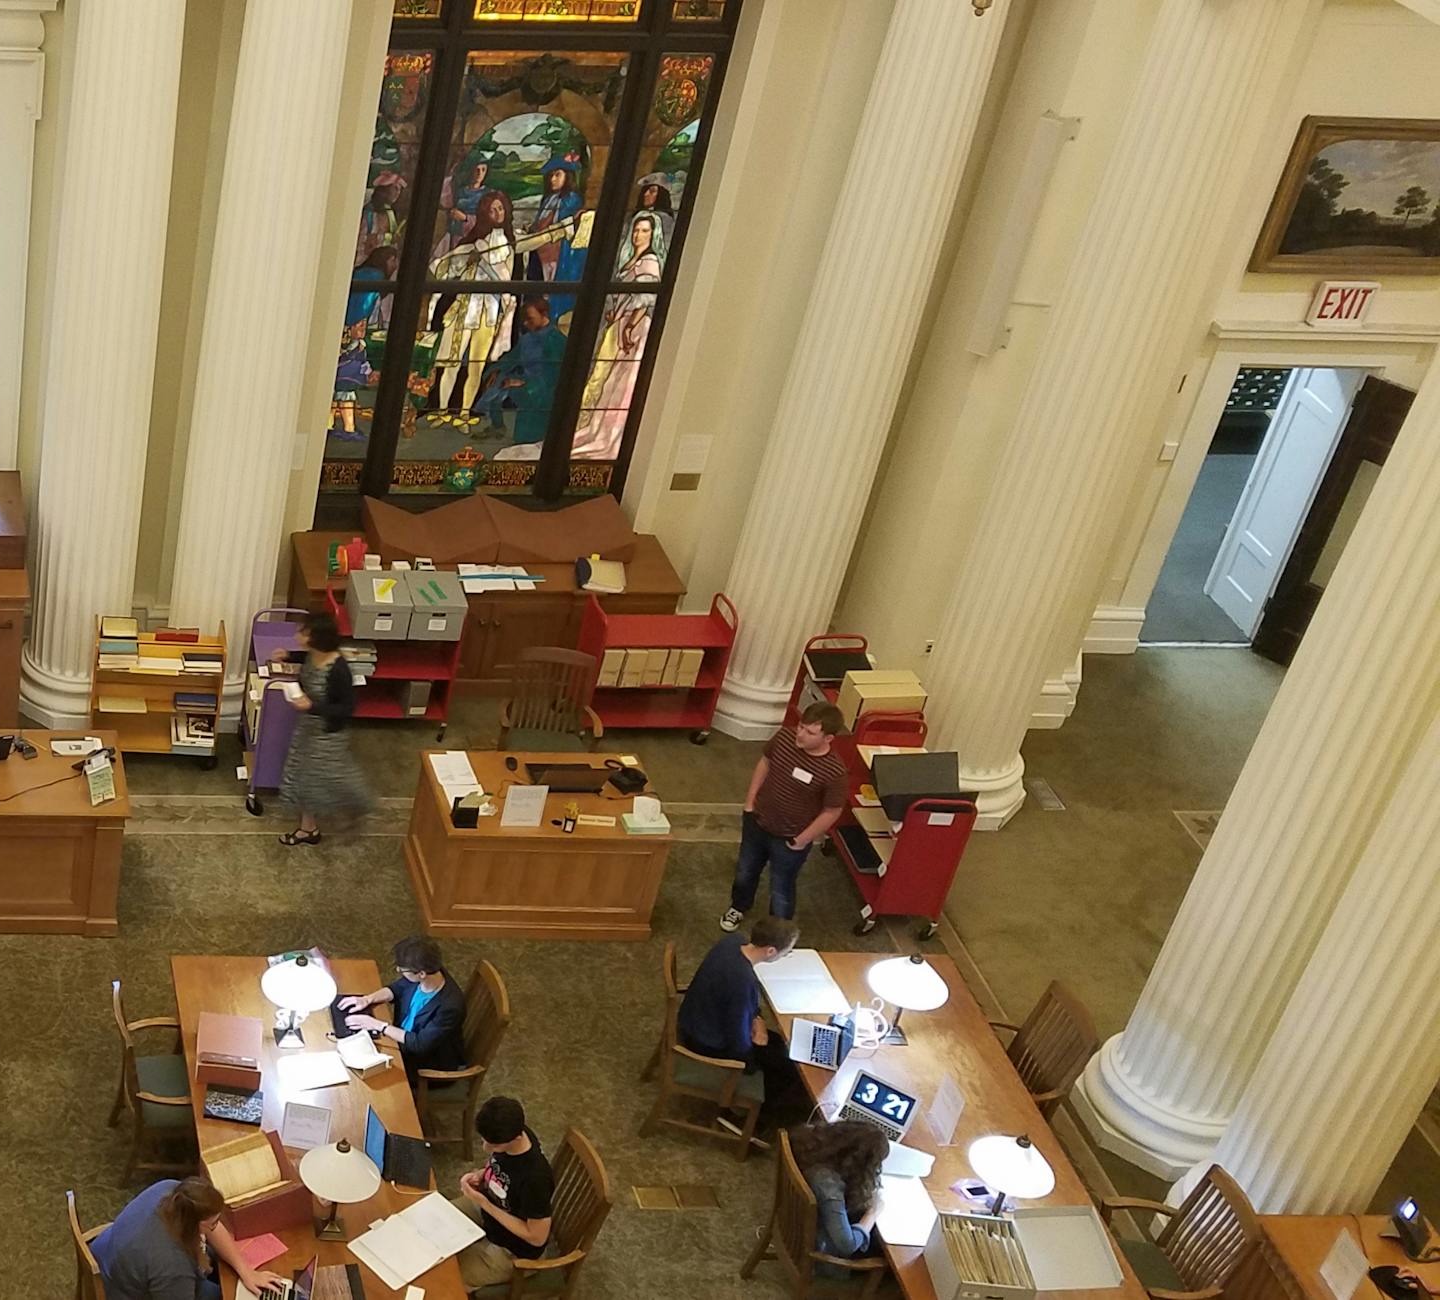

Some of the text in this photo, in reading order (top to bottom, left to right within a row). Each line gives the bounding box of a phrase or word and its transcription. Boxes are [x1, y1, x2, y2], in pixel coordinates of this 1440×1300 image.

[1317, 288, 1373, 319] EXIT
[861, 1082, 879, 1104] 3
[881, 1093, 910, 1120] 21
